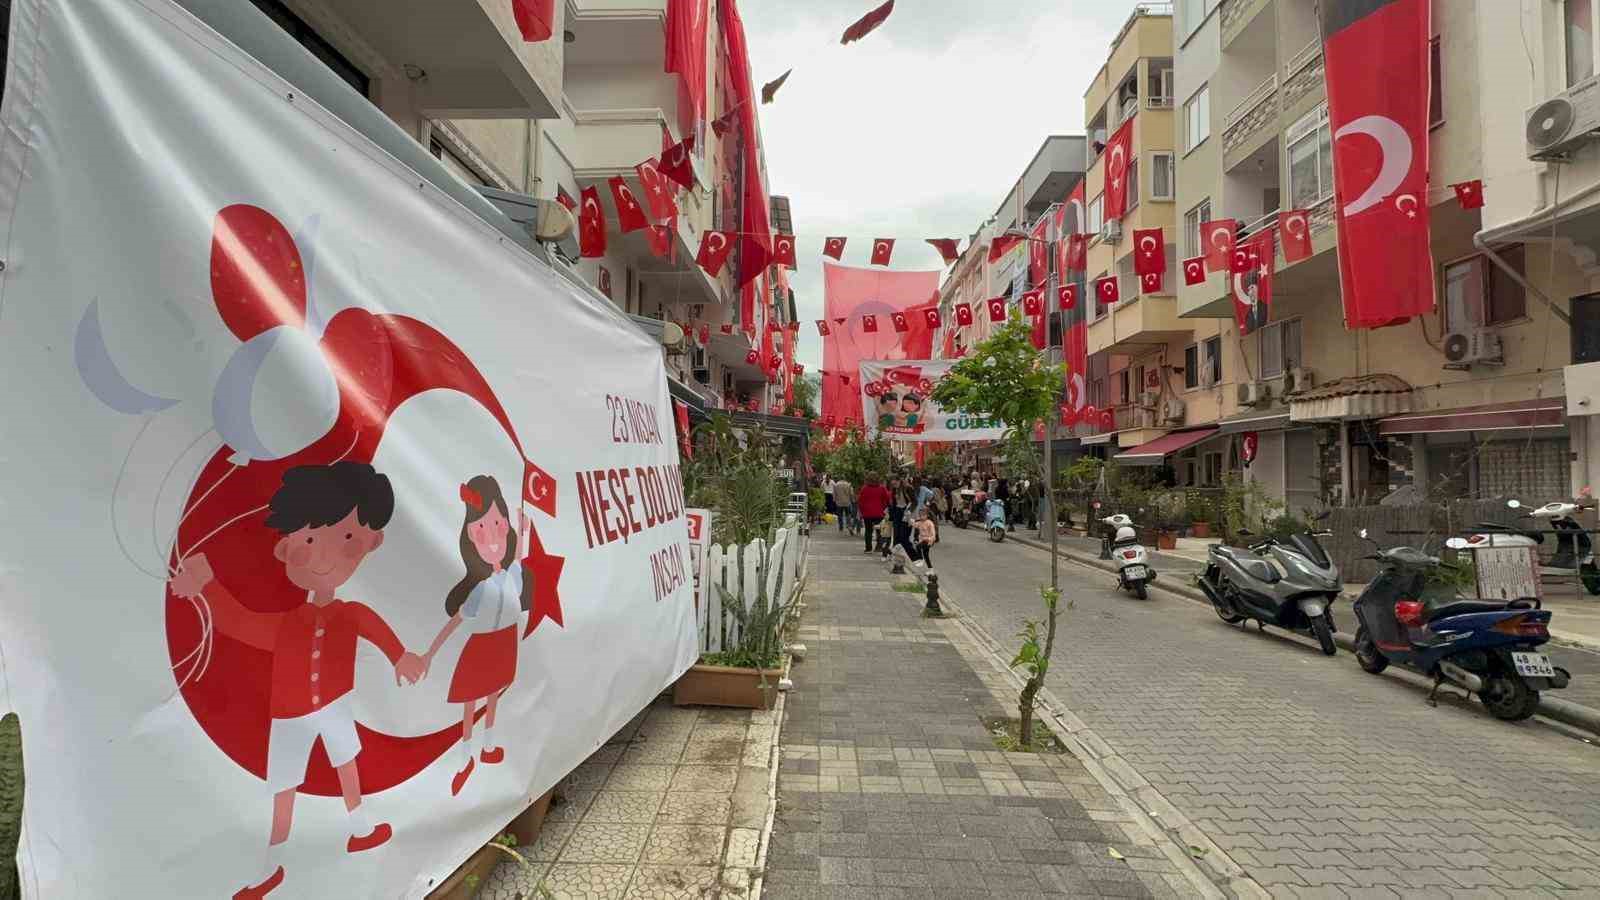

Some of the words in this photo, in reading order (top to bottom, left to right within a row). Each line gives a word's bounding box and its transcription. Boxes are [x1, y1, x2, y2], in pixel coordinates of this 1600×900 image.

[606, 393, 629, 443] 23
[575, 466, 642, 549] NEŞE
[1516, 654, 1529, 664] 48
[1525, 664, 1552, 674] 9346
